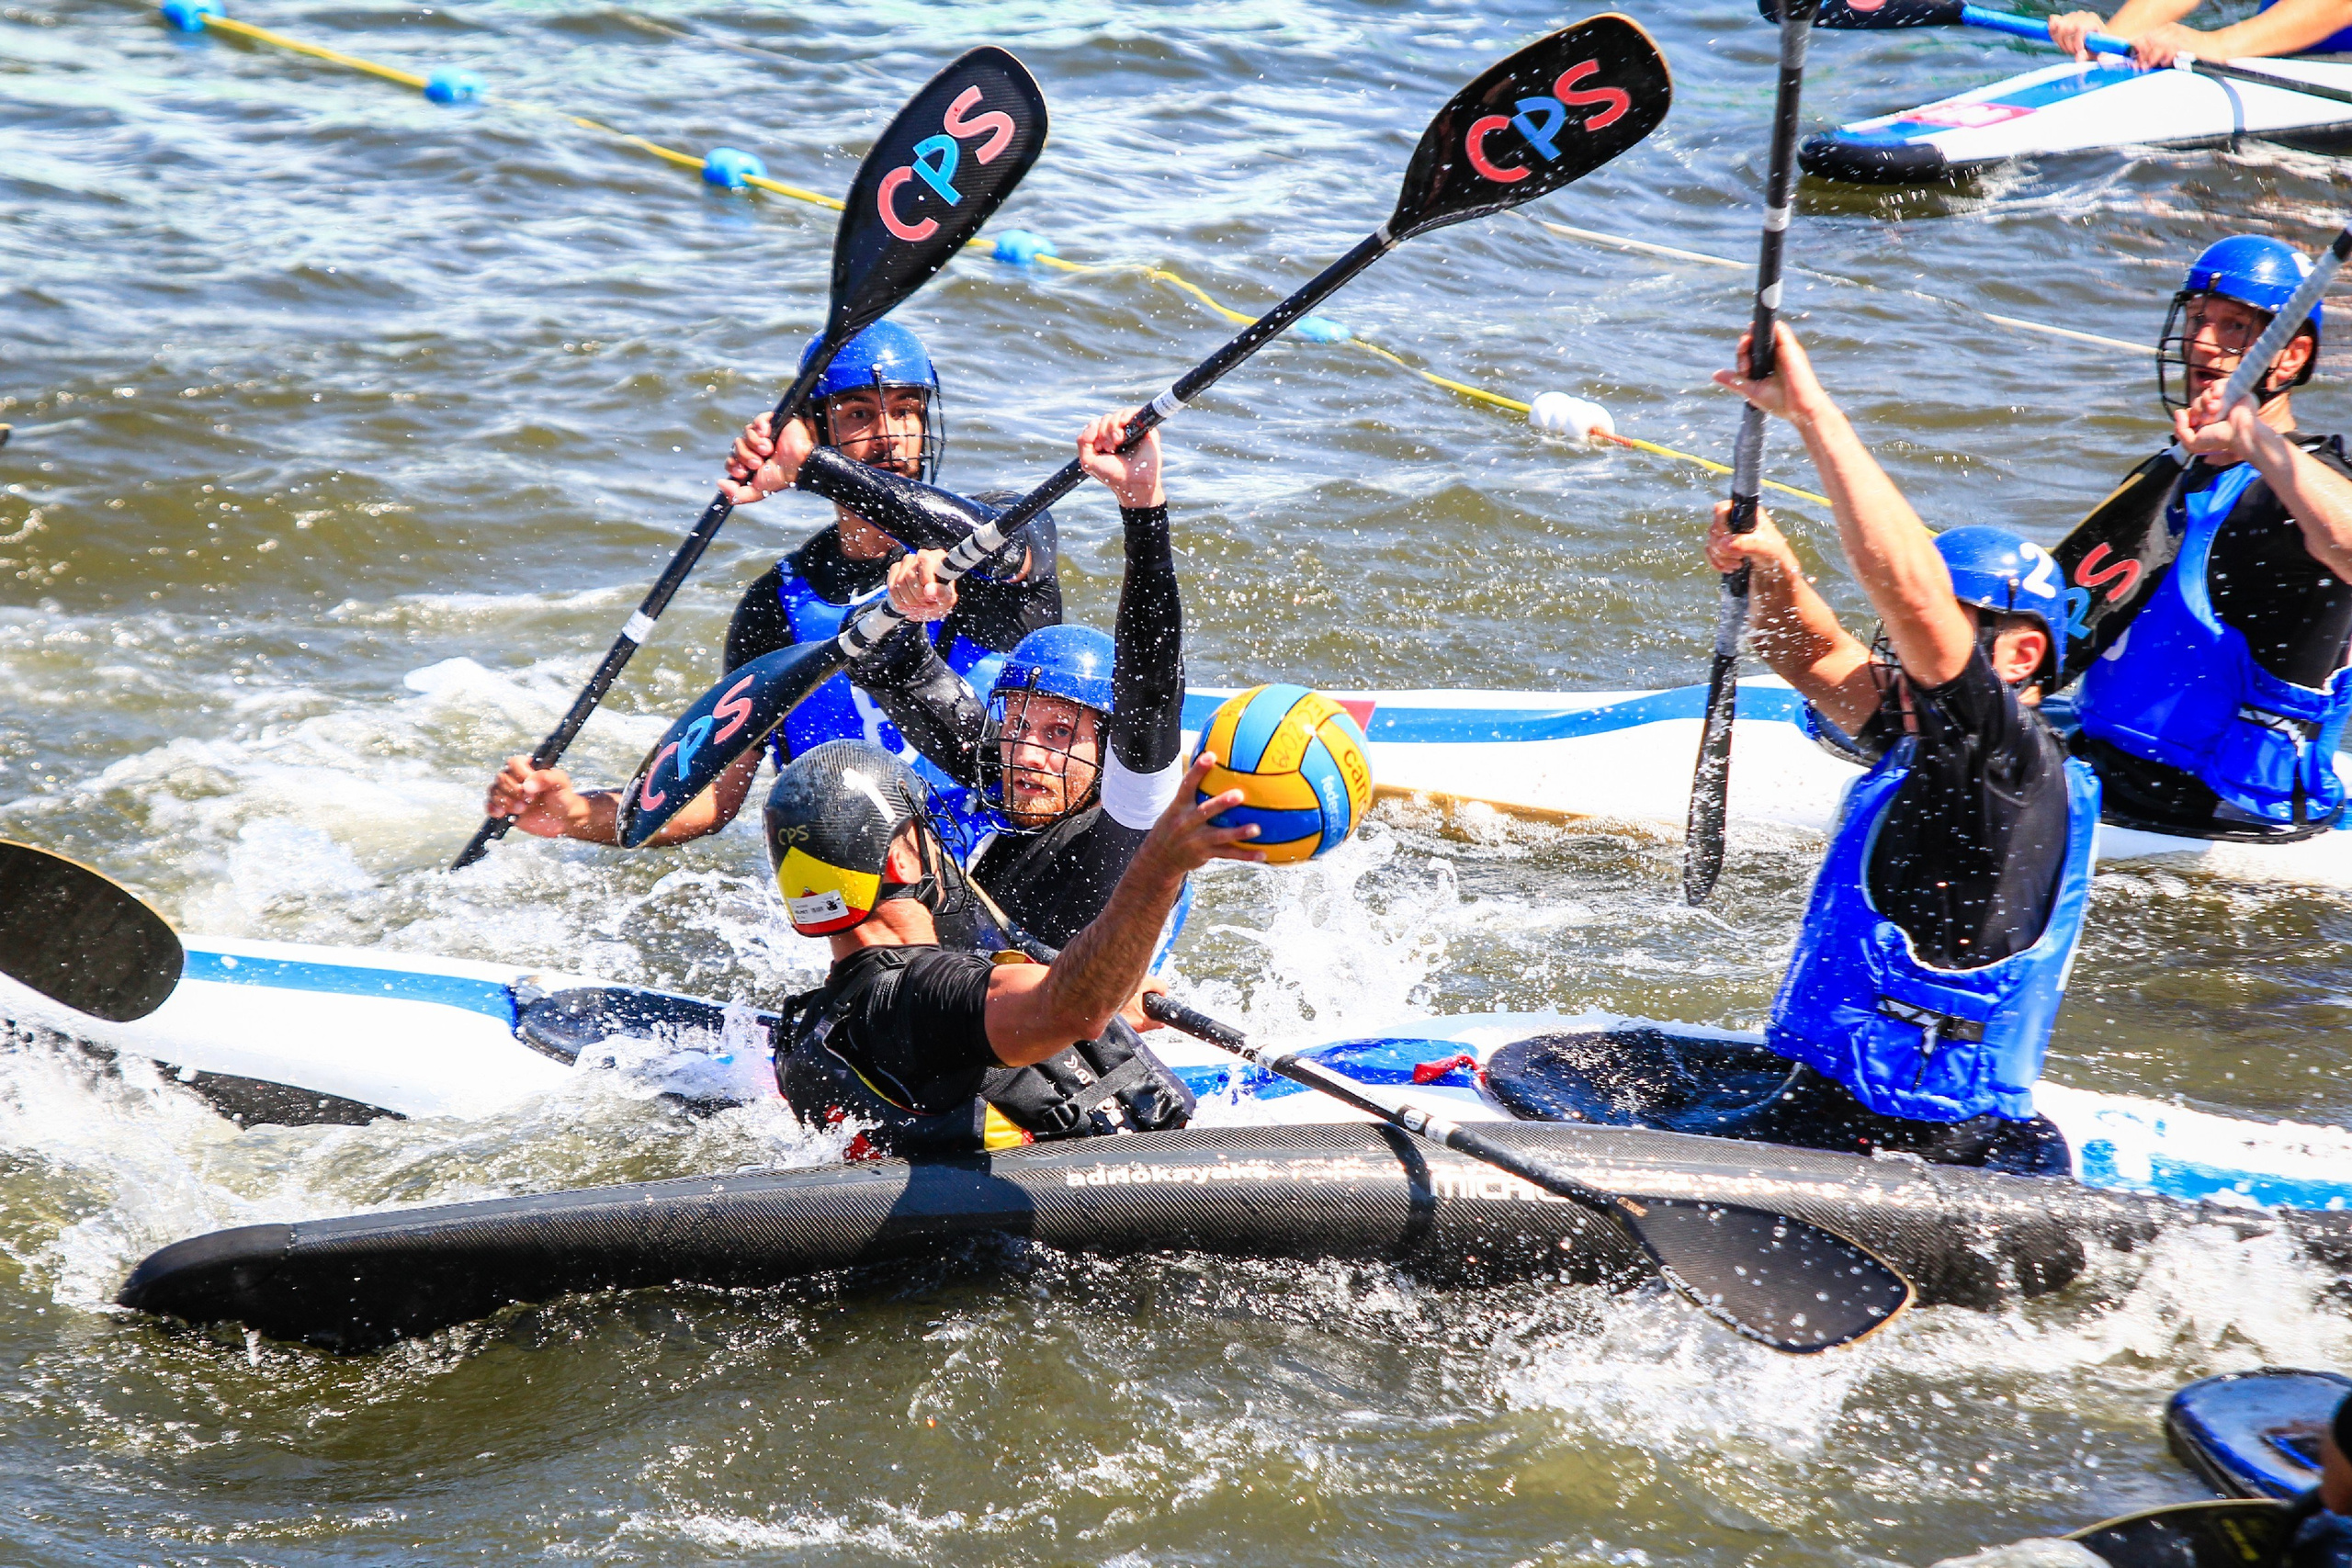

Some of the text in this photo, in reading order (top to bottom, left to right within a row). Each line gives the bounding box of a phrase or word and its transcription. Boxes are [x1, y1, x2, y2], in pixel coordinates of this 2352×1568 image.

[876, 85, 1016, 242] CPS
[1464, 59, 1632, 184] CPS
[2019, 541, 2056, 599] 2
[2066, 542, 2142, 639] PS
[640, 673, 755, 812] CPS
[777, 824, 810, 846] CPS
[841, 766, 898, 824] 1
